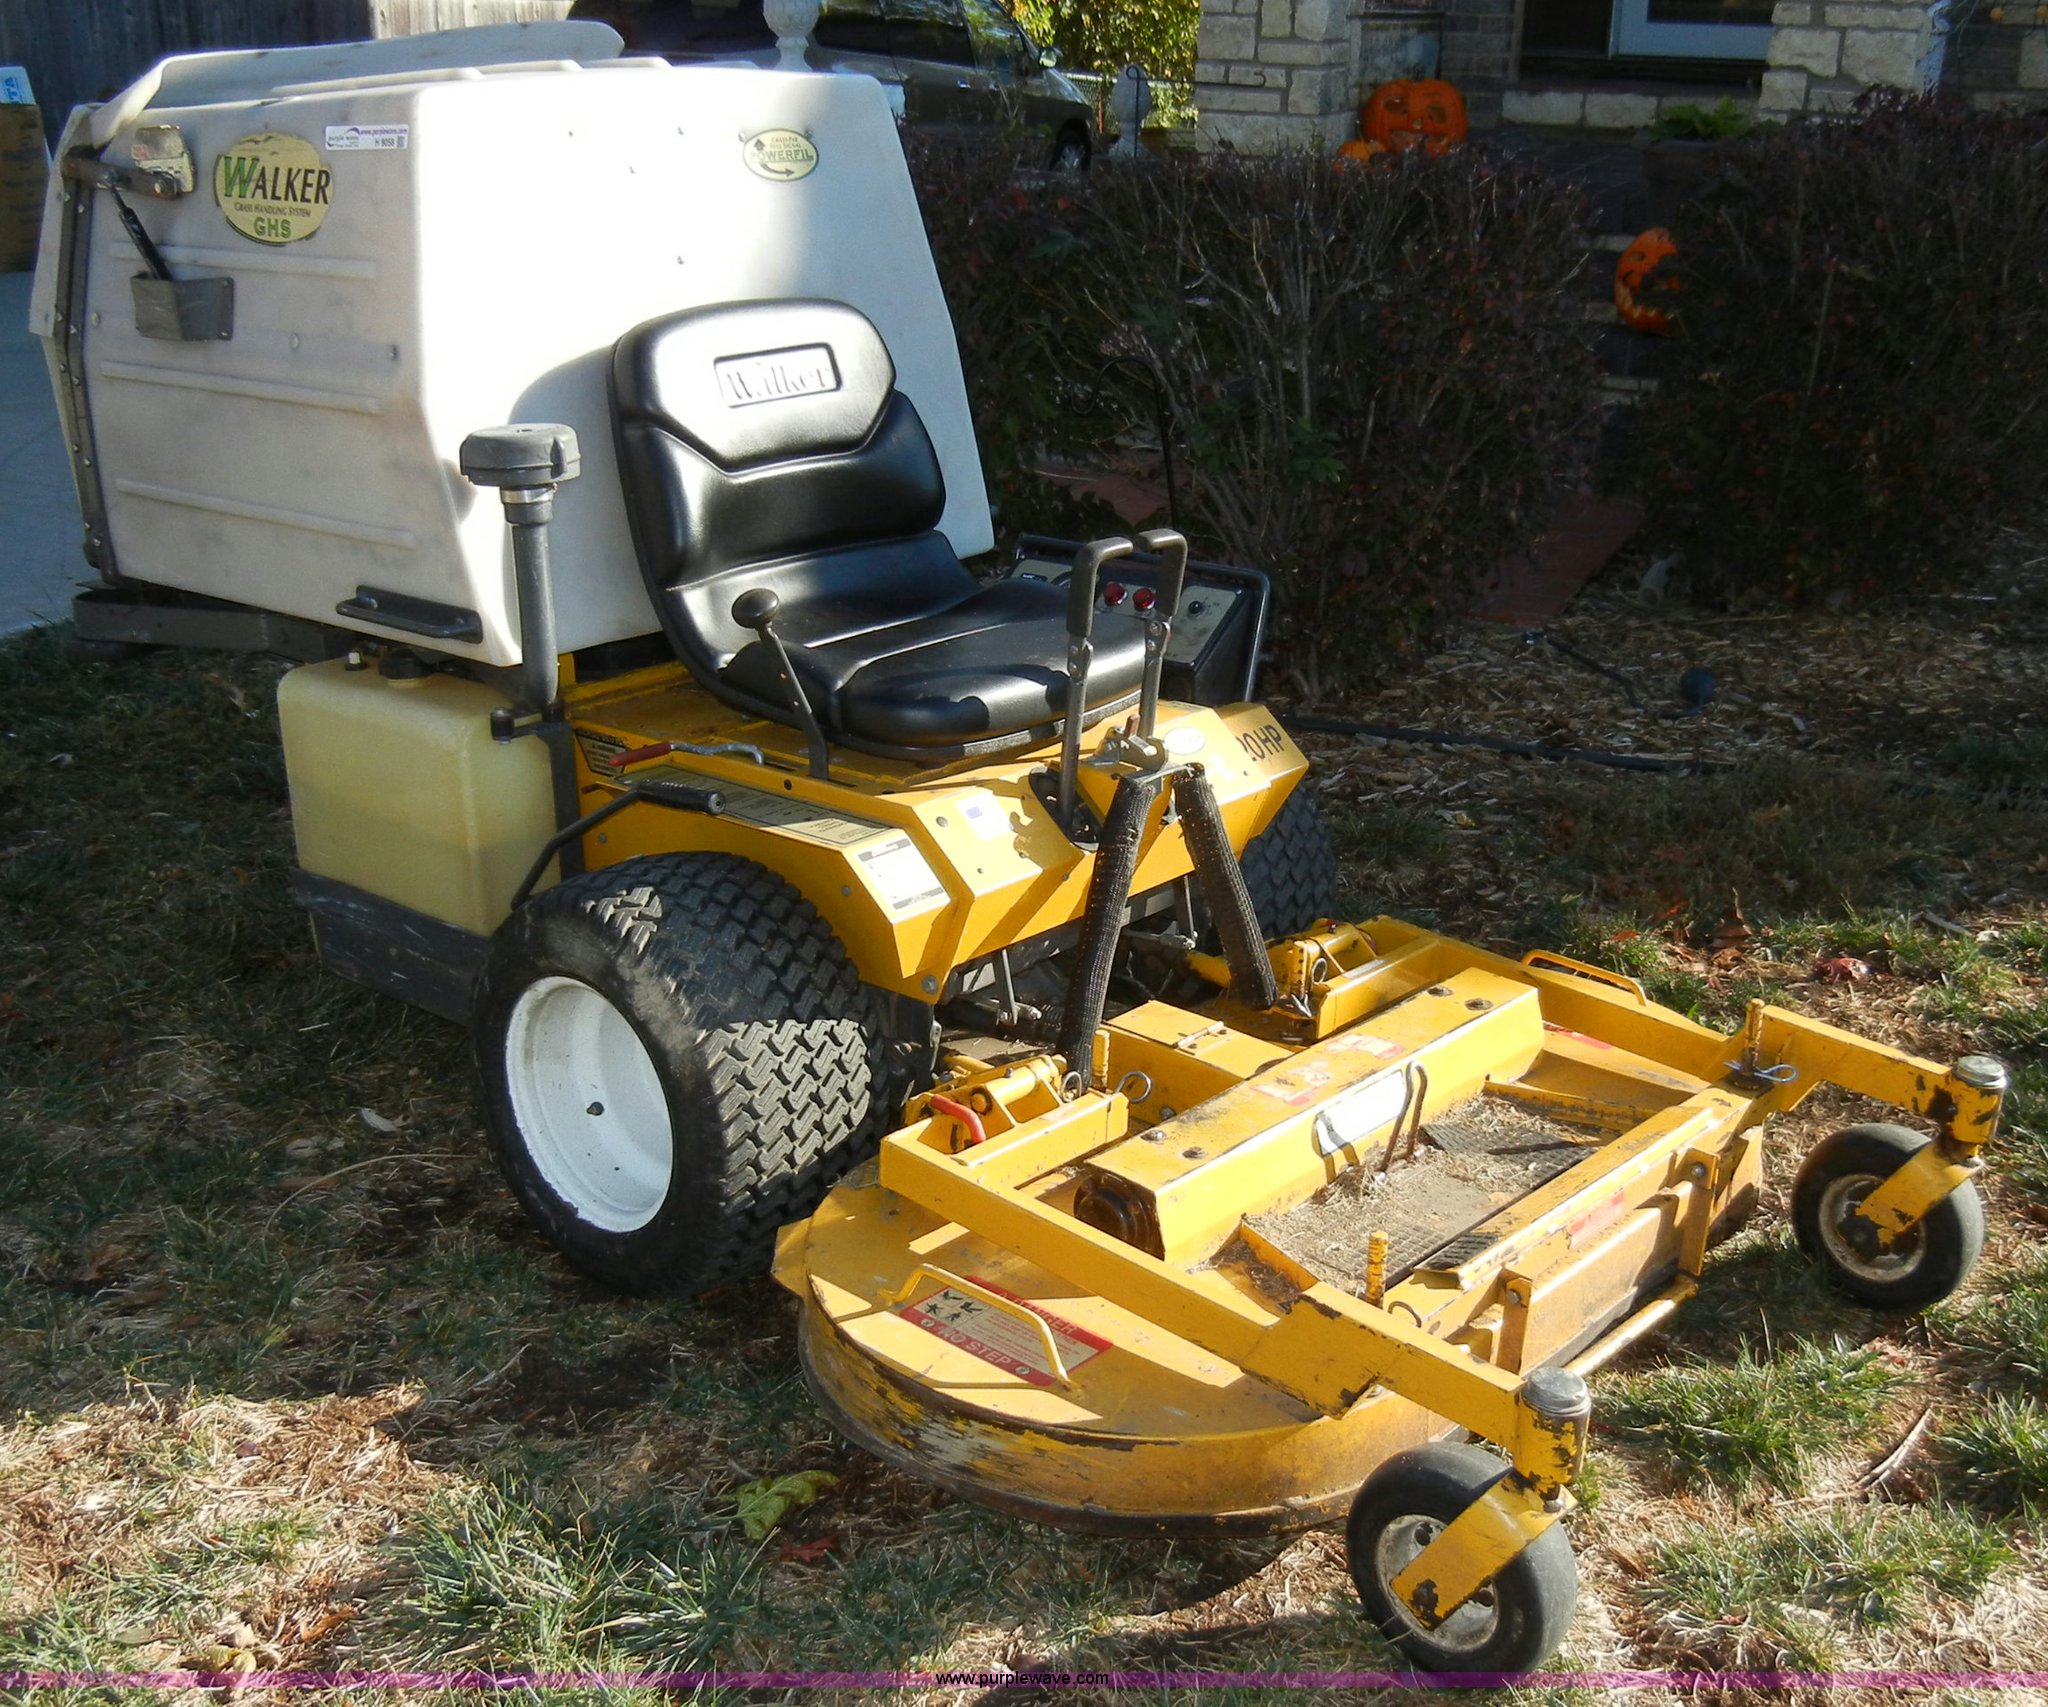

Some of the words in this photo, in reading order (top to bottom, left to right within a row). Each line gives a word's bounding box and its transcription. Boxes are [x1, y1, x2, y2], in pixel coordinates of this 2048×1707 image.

[223, 156, 331, 205] WALKER
[253, 216, 292, 239] GHS
[966, 1340, 1012, 1366] STEP
